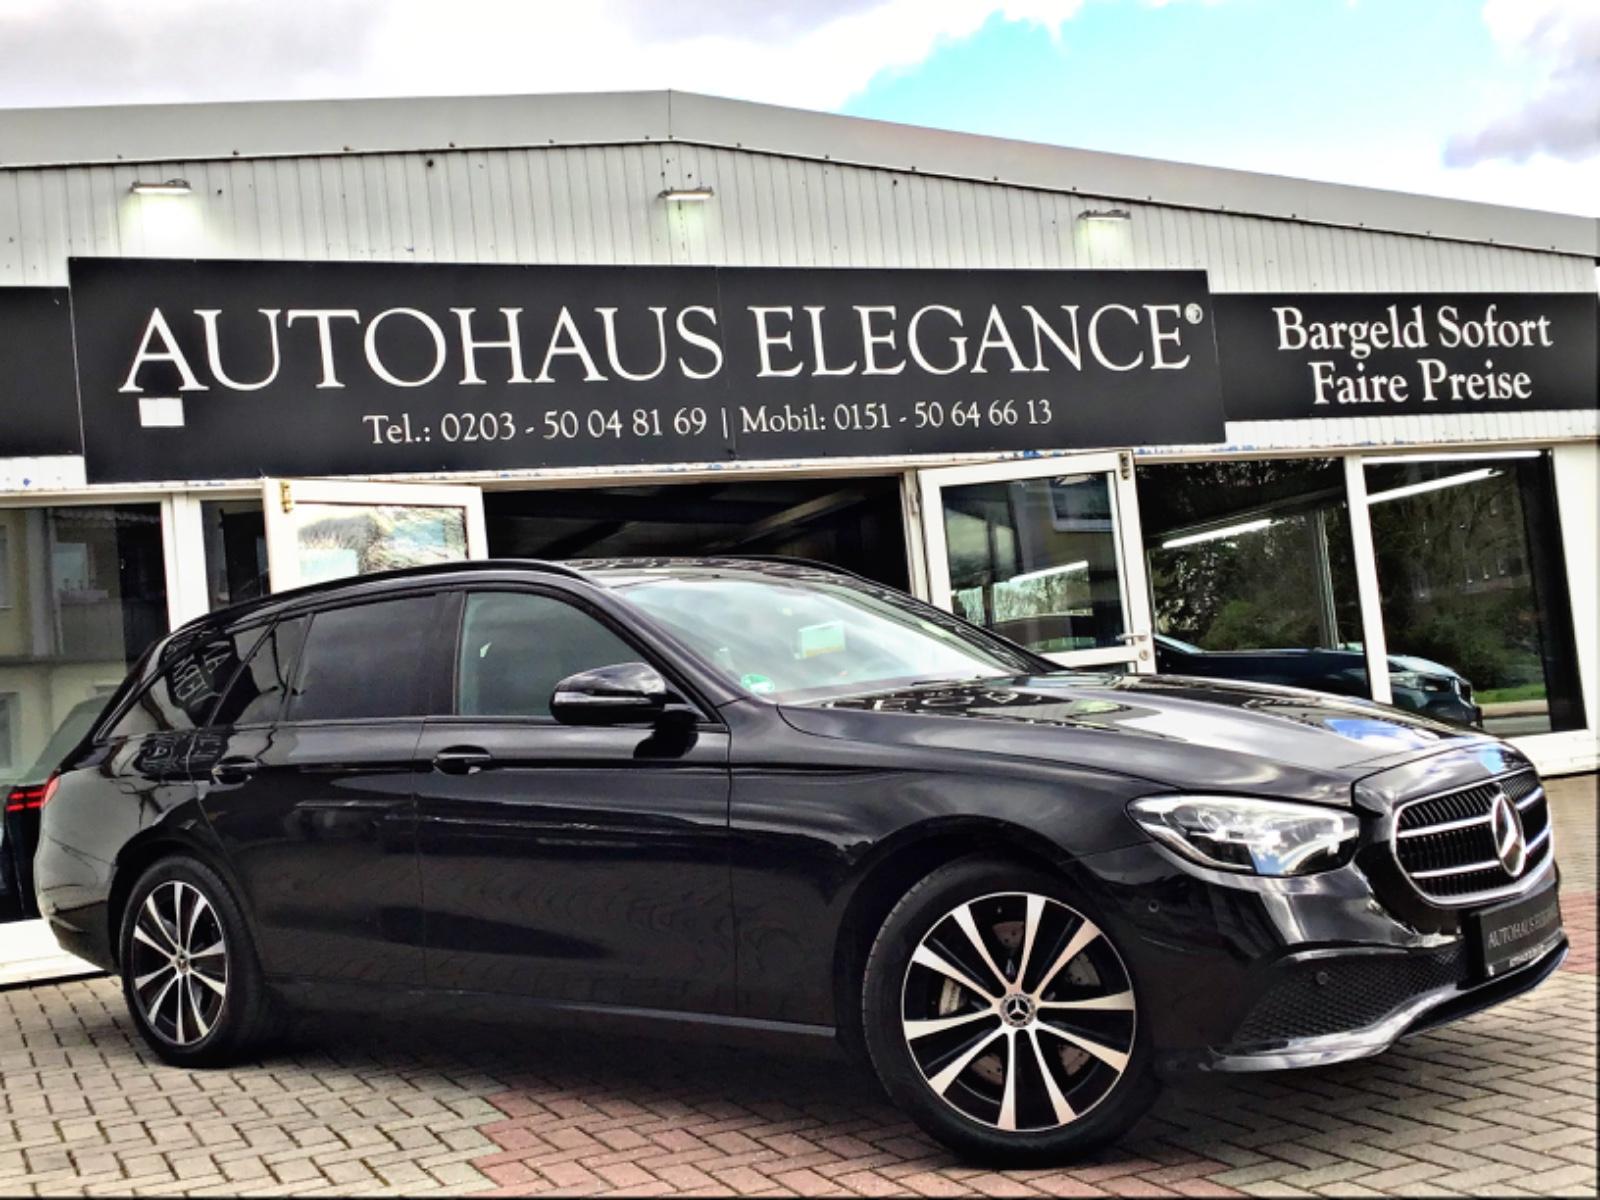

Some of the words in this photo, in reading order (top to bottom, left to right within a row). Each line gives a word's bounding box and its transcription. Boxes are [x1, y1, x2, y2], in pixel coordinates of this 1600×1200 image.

[118, 306, 724, 392] AUTOHAUS
[1272, 305, 1428, 359] Bargeld
[1437, 304, 1553, 348] Sofort
[1308, 360, 1409, 404] Faire
[1416, 358, 1532, 401] Preise
[362, 413, 431, 444] Tel.:
[440, 412, 516, 442] 0203
[543, 410, 579, 439] 50
[587, 409, 623, 438] 04
[632, 408, 663, 436] 81
[673, 407, 707, 435] 69
[739, 403, 826, 433] Mobil:
[833, 402, 892, 431] 0151
[914, 401, 944, 428] 50
[950, 401, 981, 428] 64
[988, 399, 1018, 426] 66
[1026, 398, 1052, 424] 13
